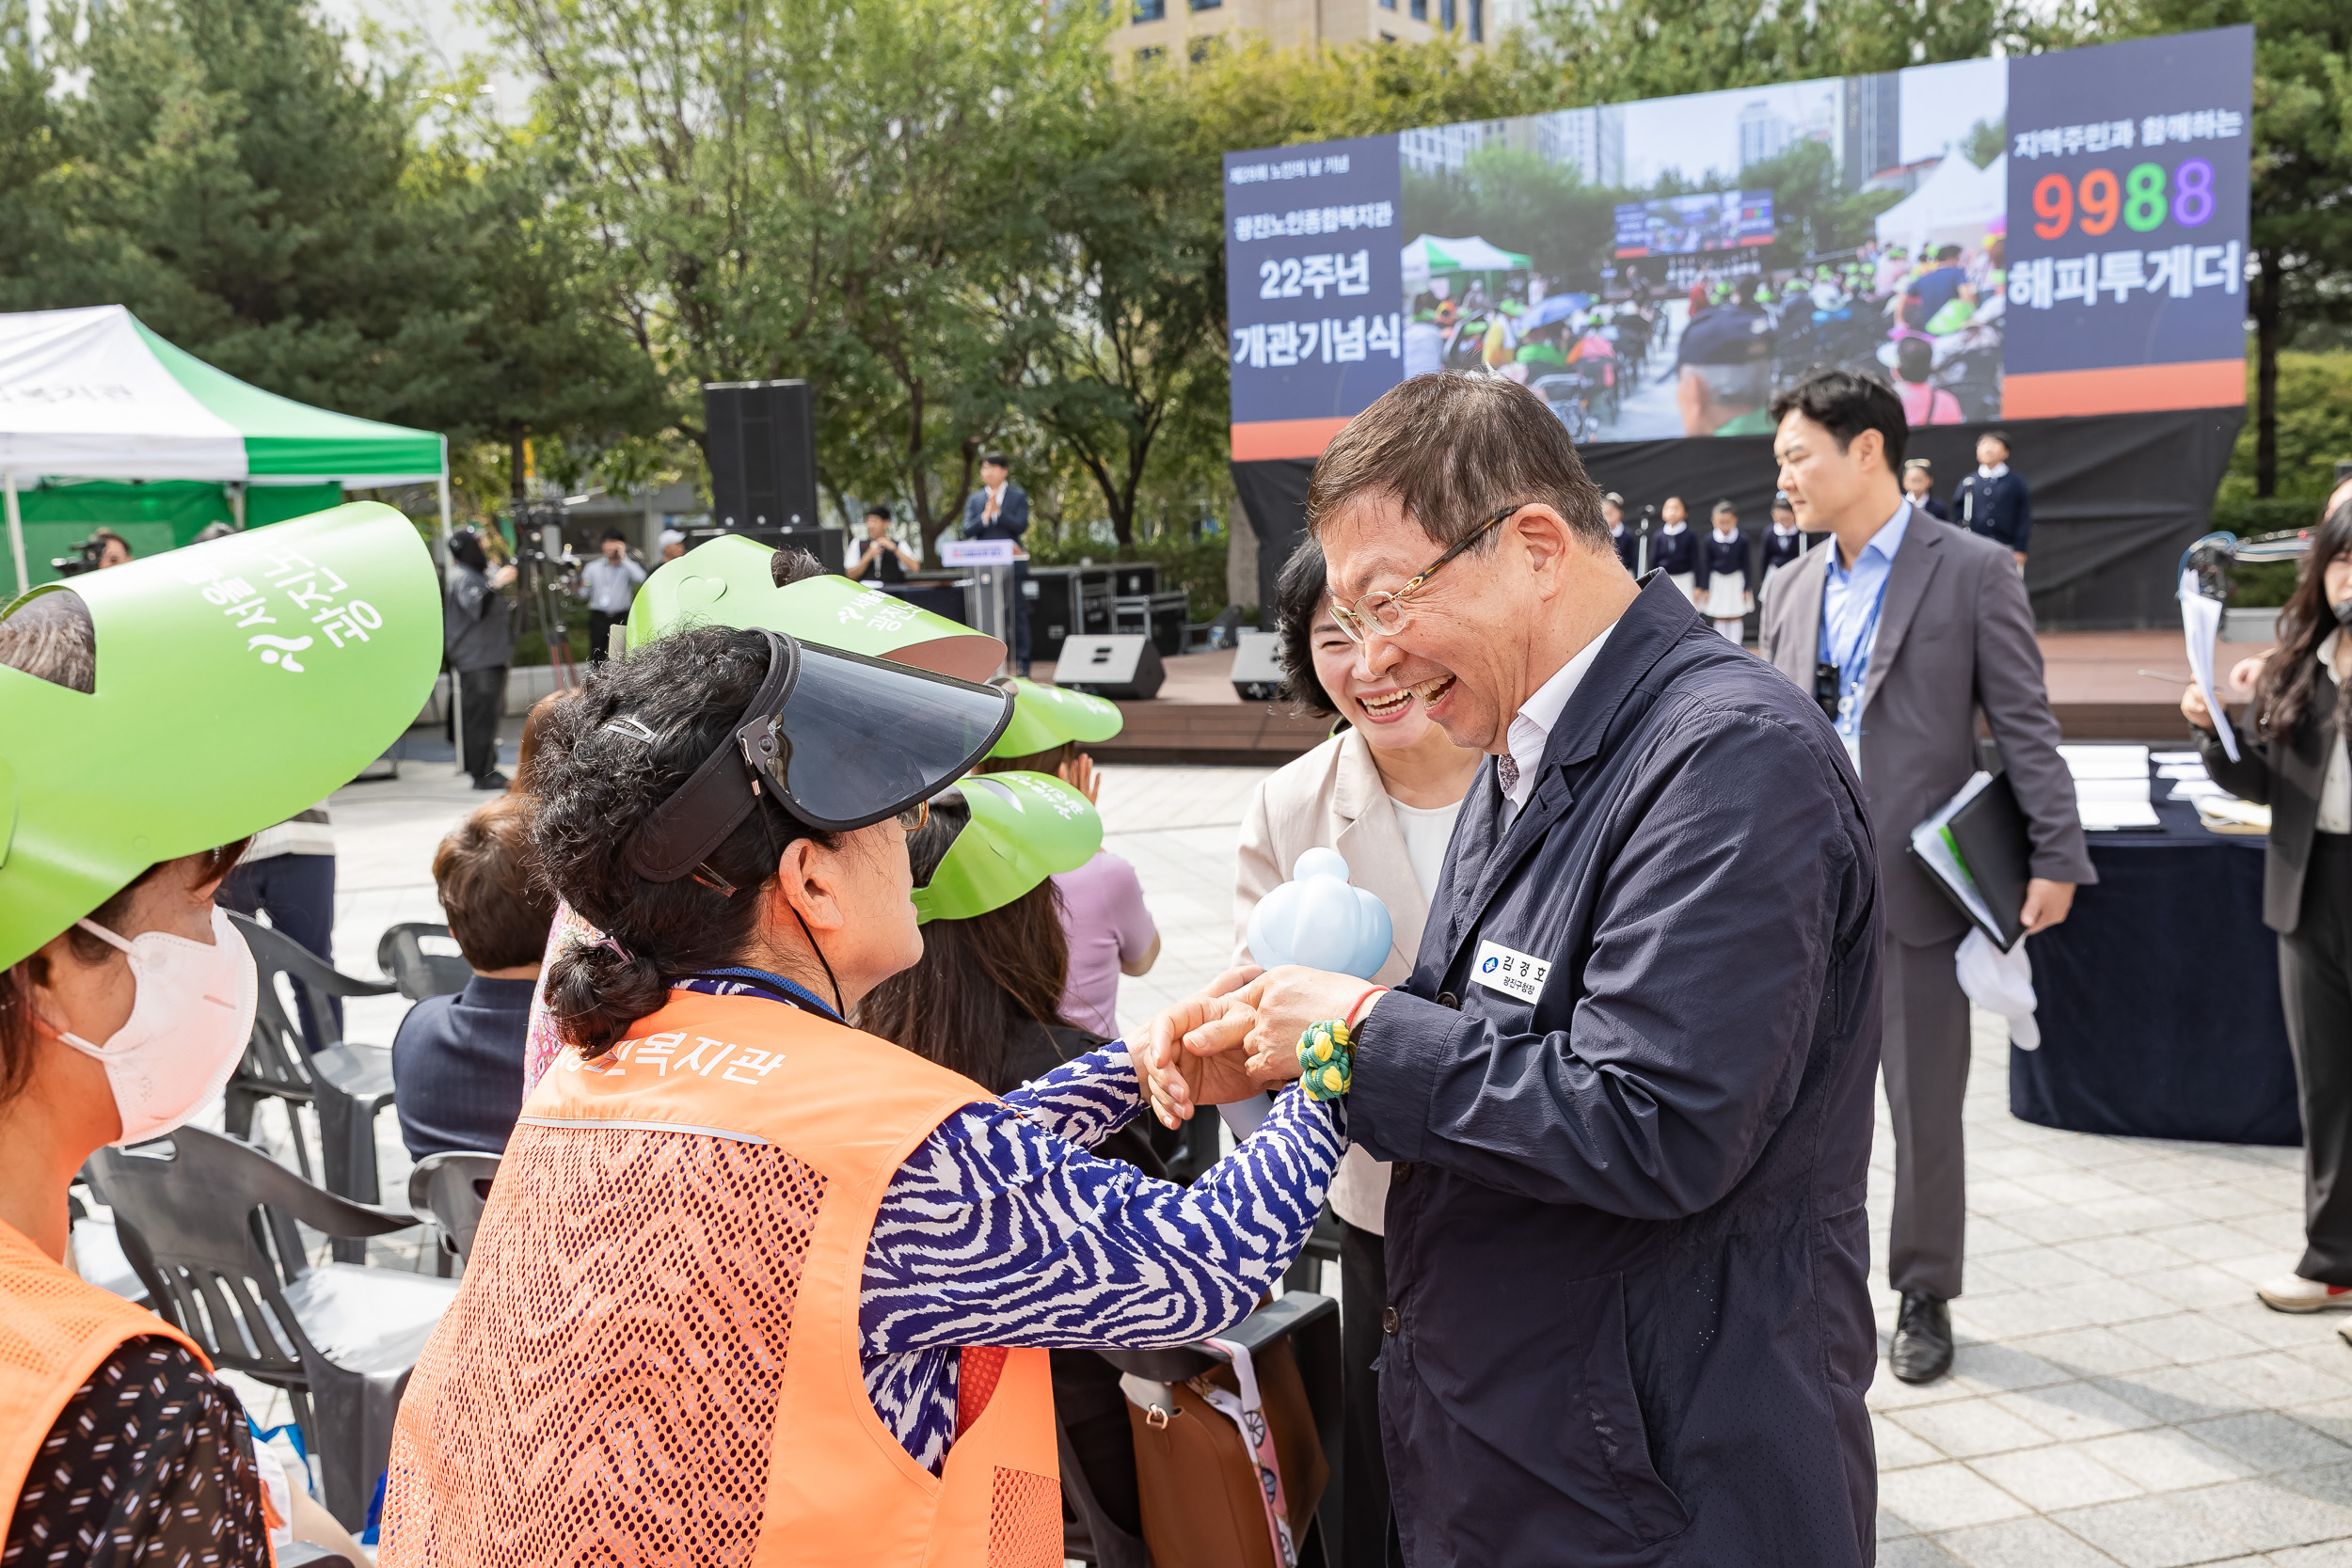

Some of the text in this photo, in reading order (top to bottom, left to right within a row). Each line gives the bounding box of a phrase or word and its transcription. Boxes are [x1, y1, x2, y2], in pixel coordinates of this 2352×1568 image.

[2013, 108, 2244, 160] 지역주민과 함께하는
[1269, 158, 1307, 180] 노인의
[1308, 156, 1322, 177] 날
[1324, 153, 1349, 175] 기념
[1234, 200, 1393, 242] 광진노인종합복지관
[2032, 157, 2217, 241] 9988
[1260, 248, 1370, 299] 22주년
[2007, 239, 2241, 309] 해피투게더
[1233, 312, 1400, 368] 개관기념식
[1503, 975, 1535, 995] 광진구청장
[585, 1032, 787, 1085] 복지관
